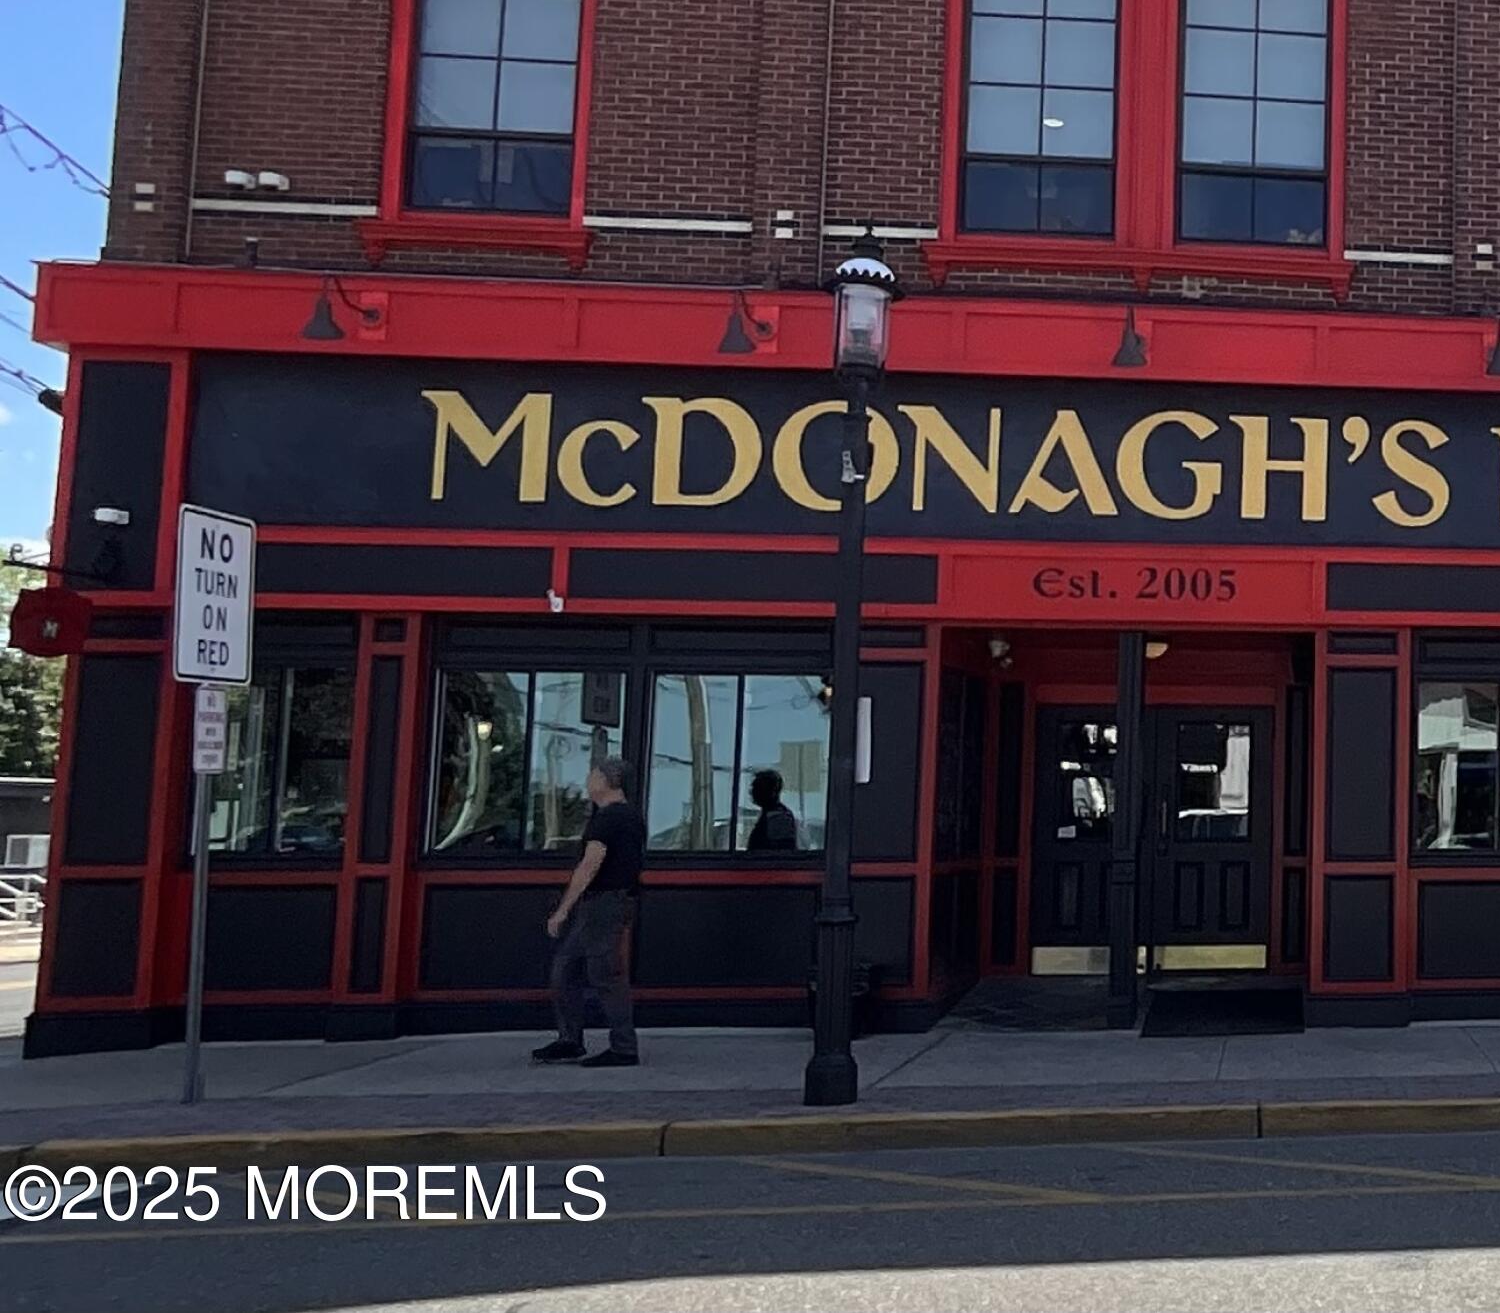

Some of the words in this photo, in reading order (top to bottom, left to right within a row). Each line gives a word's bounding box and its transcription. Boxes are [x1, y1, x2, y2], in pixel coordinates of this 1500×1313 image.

[200, 528, 234, 563] NO
[195, 568, 239, 599] TURN
[1033, 568, 1118, 599] Est.
[1136, 567, 1237, 602] 2005
[202, 605, 228, 631] ON
[197, 639, 230, 666] RED
